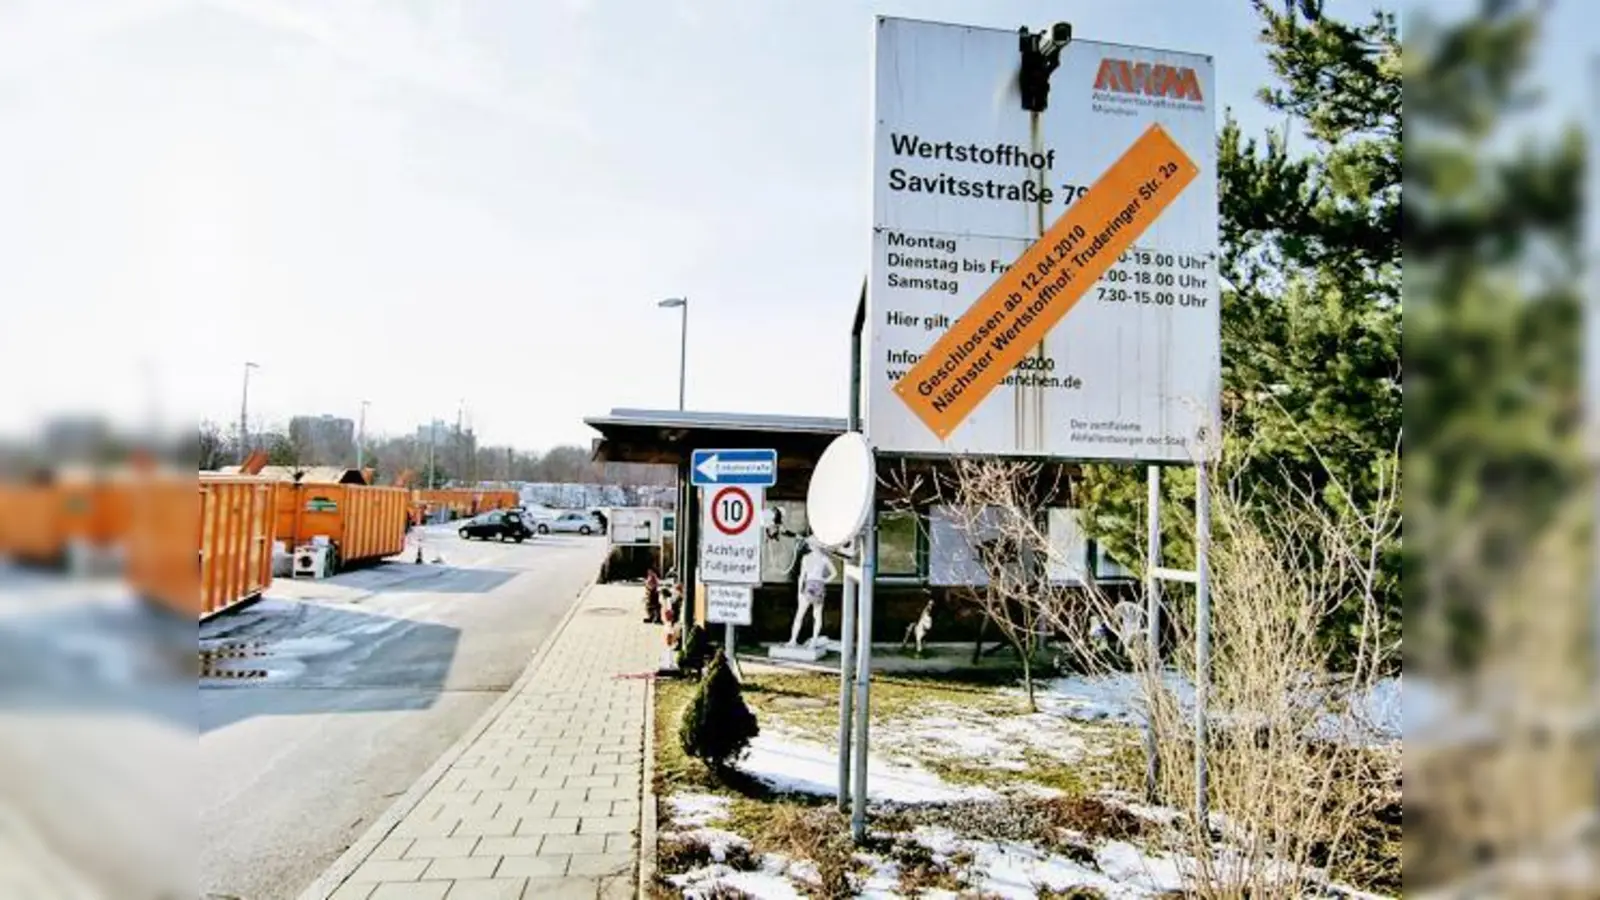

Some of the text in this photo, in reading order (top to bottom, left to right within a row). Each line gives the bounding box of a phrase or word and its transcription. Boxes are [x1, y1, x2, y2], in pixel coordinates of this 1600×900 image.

[890, 132, 1055, 170] Wertstoffhof
[888, 168, 1053, 205] Savitsstraße
[887, 231, 957, 254] Montag
[887, 252, 959, 274] Dienstag
[962, 258, 986, 273] bis
[1179, 255, 1207, 270] Uhr
[887, 270, 1207, 295] Samstag .00-18.00 Uhr
[932, 161, 1178, 413] Nächster Wertstoffhof: Truderinger Str. 2a
[1097, 287, 1207, 308] 7.30-15.00 Uhr
[886, 311, 919, 327] Hier
[924, 314, 950, 331] gilt
[918, 225, 1086, 396] Geschlossen ab 12.04.2010
[722, 499, 743, 522] 10
